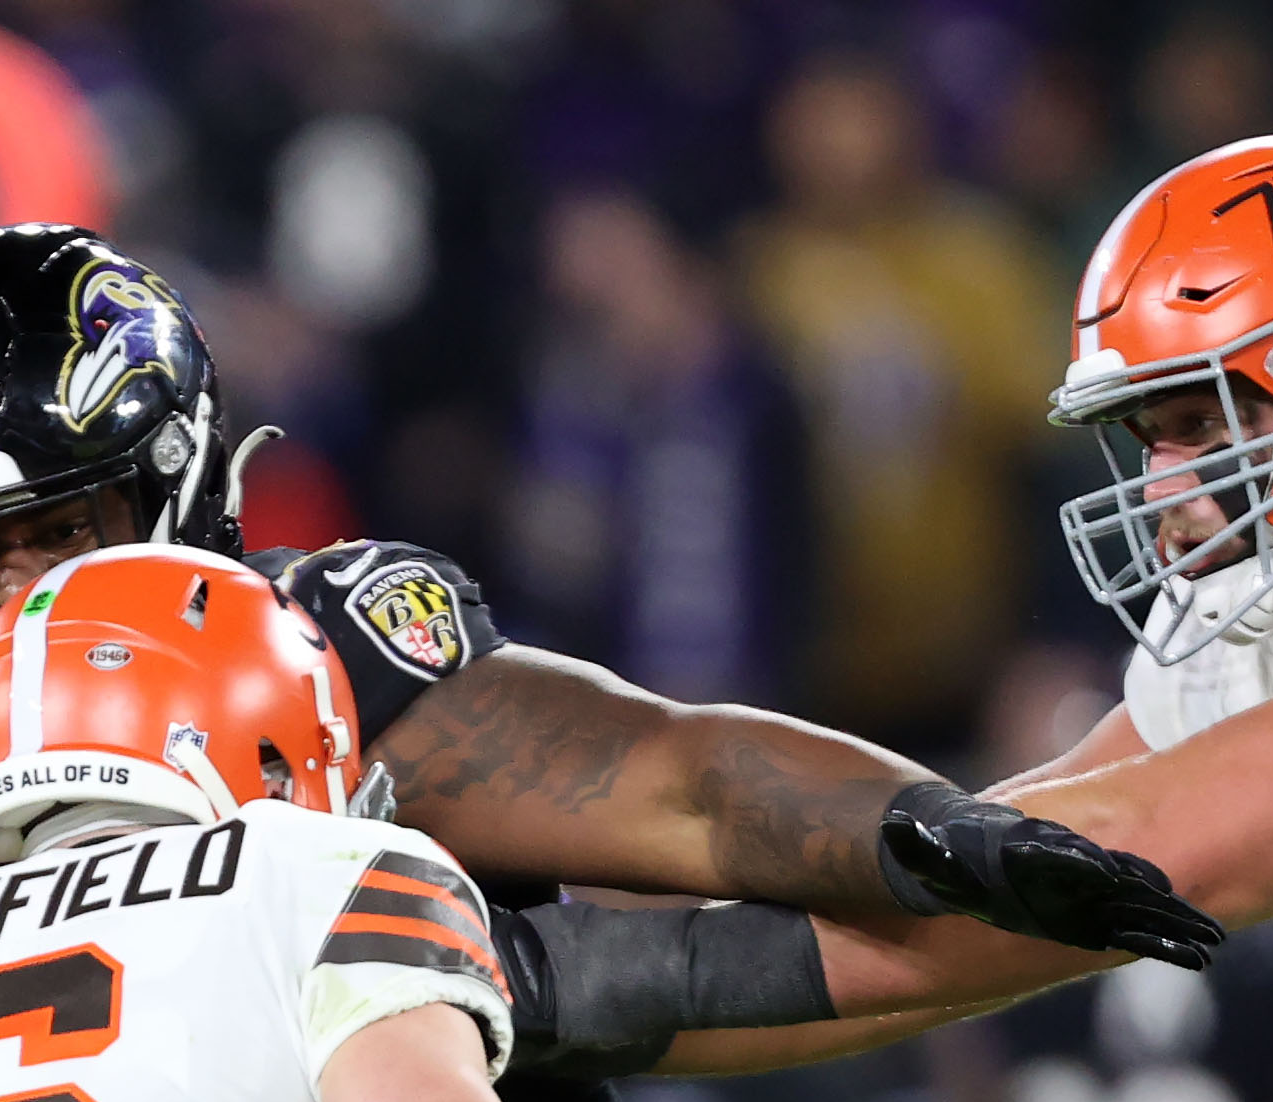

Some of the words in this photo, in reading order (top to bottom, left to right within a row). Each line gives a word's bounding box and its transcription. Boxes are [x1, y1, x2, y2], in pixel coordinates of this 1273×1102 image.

[358, 567, 427, 609] RAVENS
[95, 649, 123, 662] 1946
[21, 766, 58, 789] ALL
[64, 764, 92, 783] OF
[99, 766, 130, 786] US
